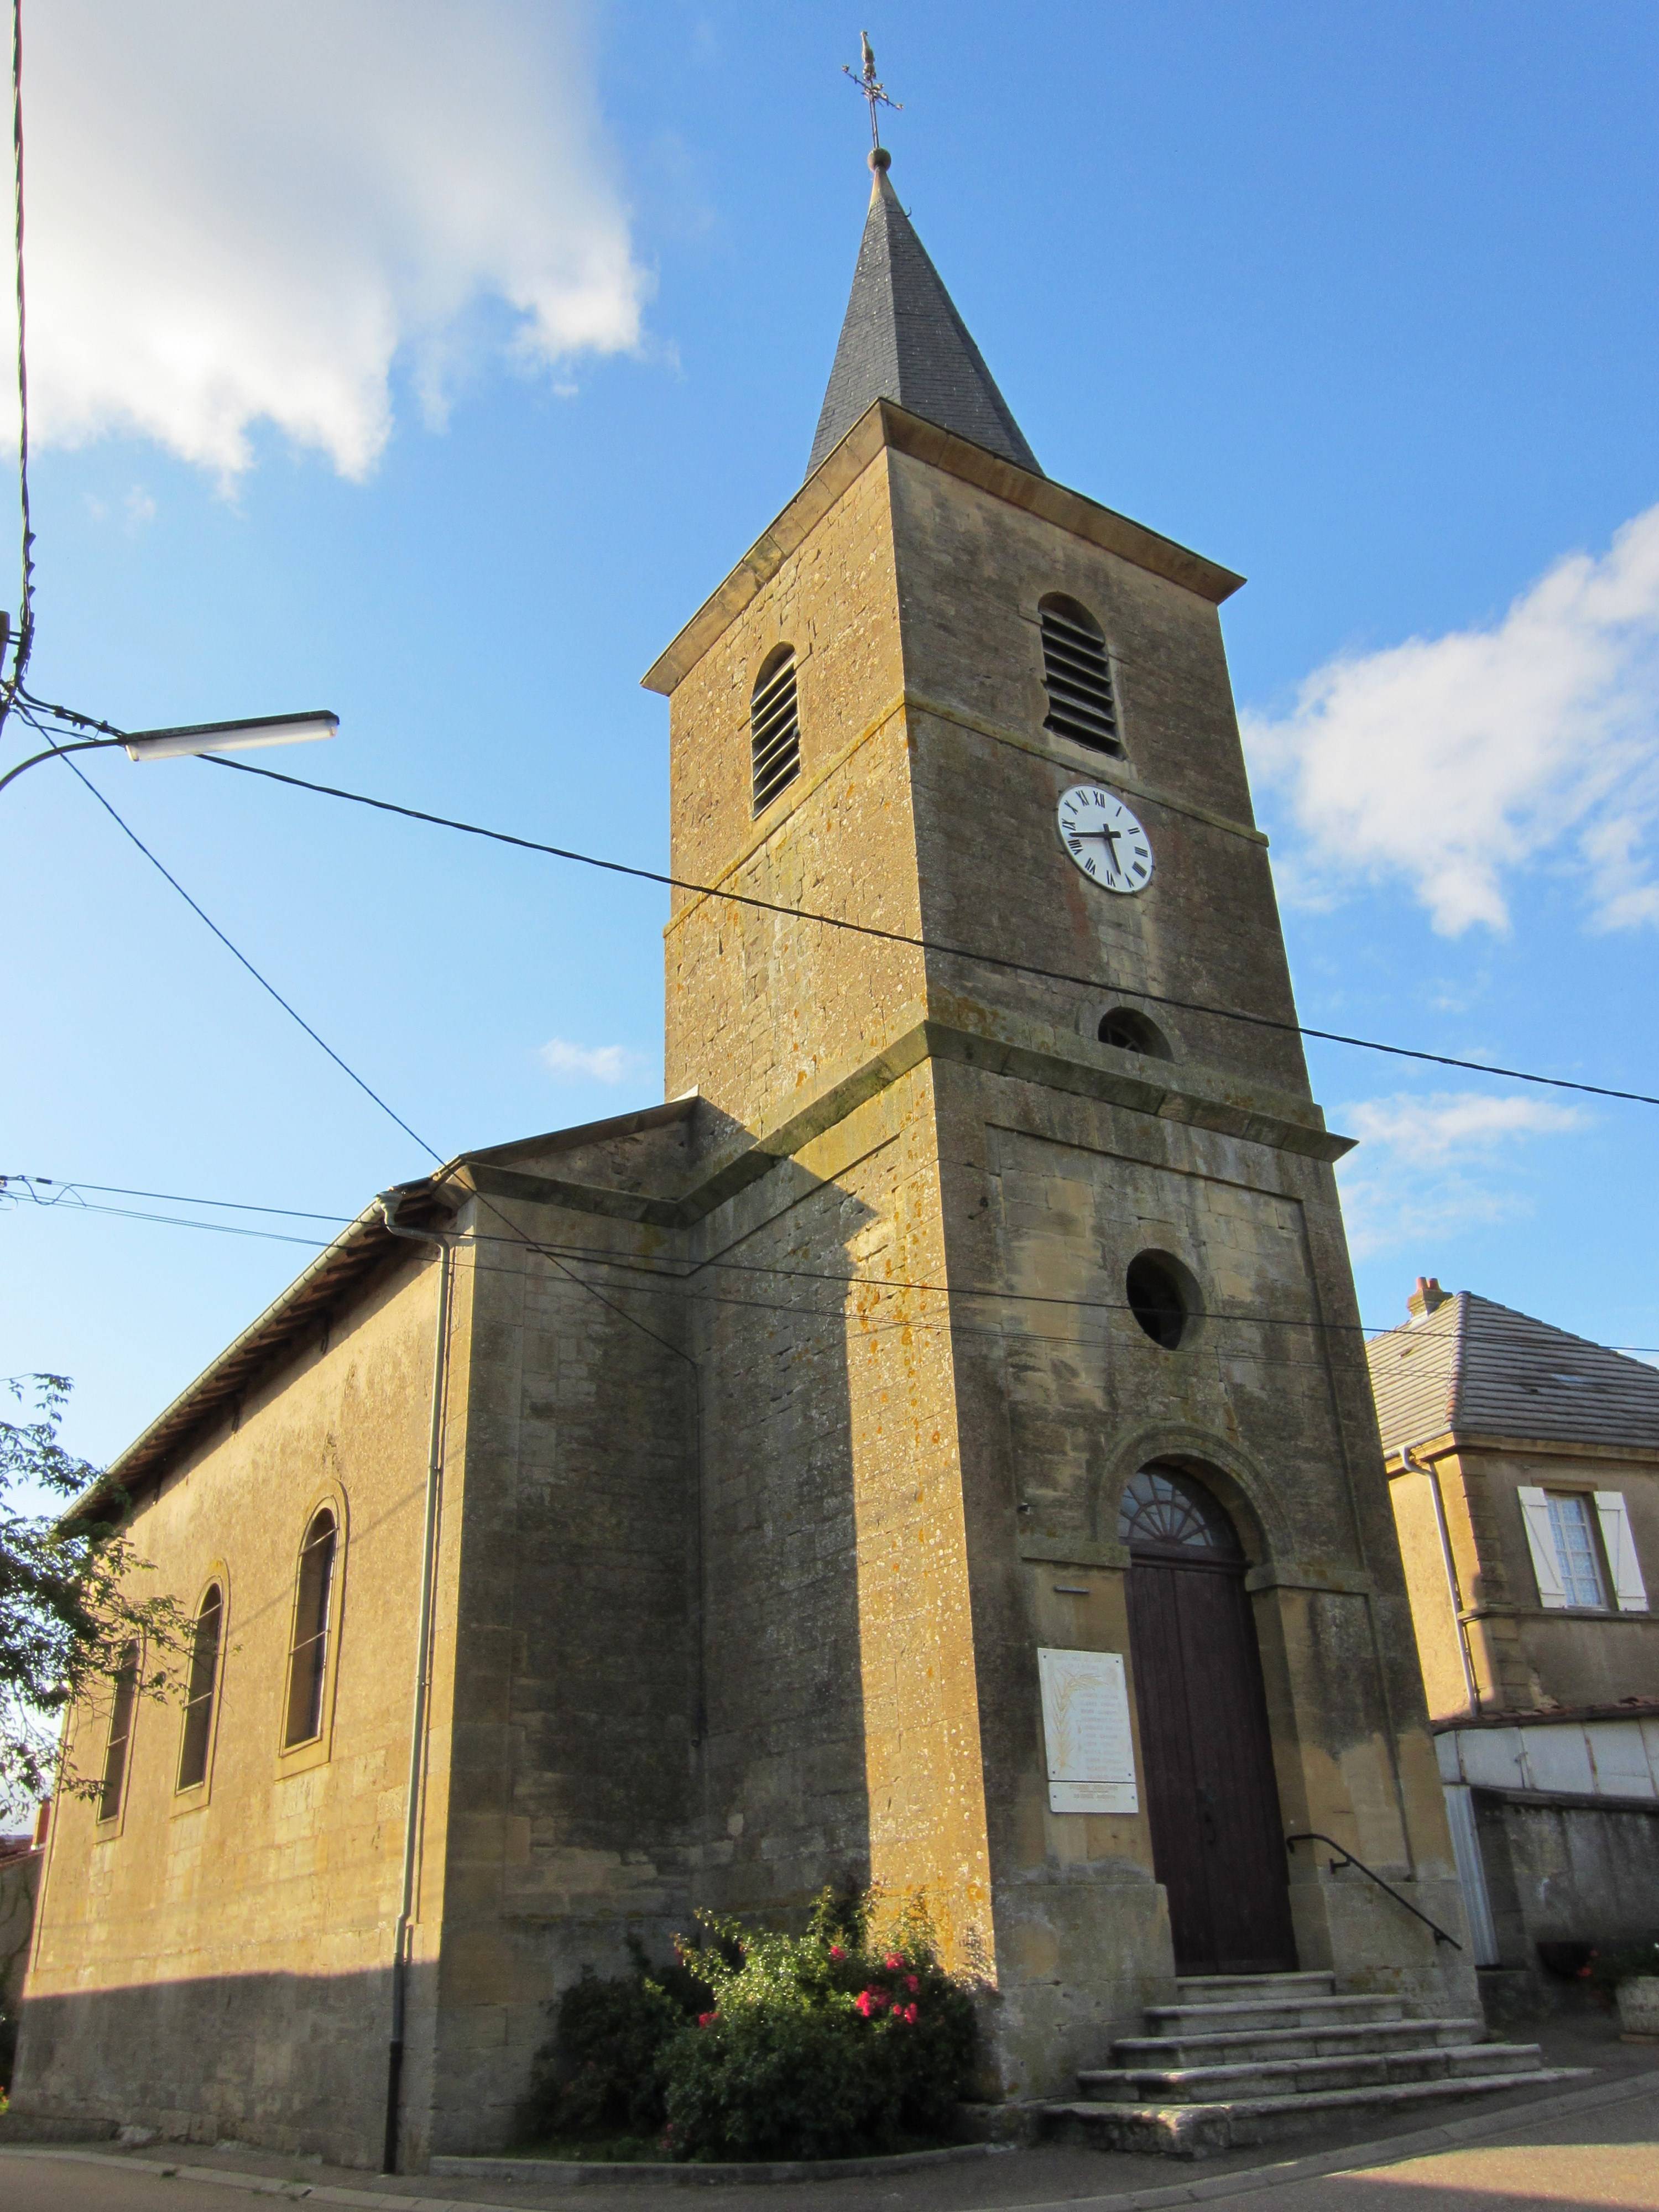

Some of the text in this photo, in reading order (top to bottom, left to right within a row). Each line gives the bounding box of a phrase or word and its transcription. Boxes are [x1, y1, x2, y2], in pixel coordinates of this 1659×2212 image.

[1076, 790, 1089, 806] XI
[1093, 790, 1105, 808] XII
[1064, 800, 1078, 815] X
[1134, 846, 1148, 857] III
[1107, 870, 1115, 887] VI
